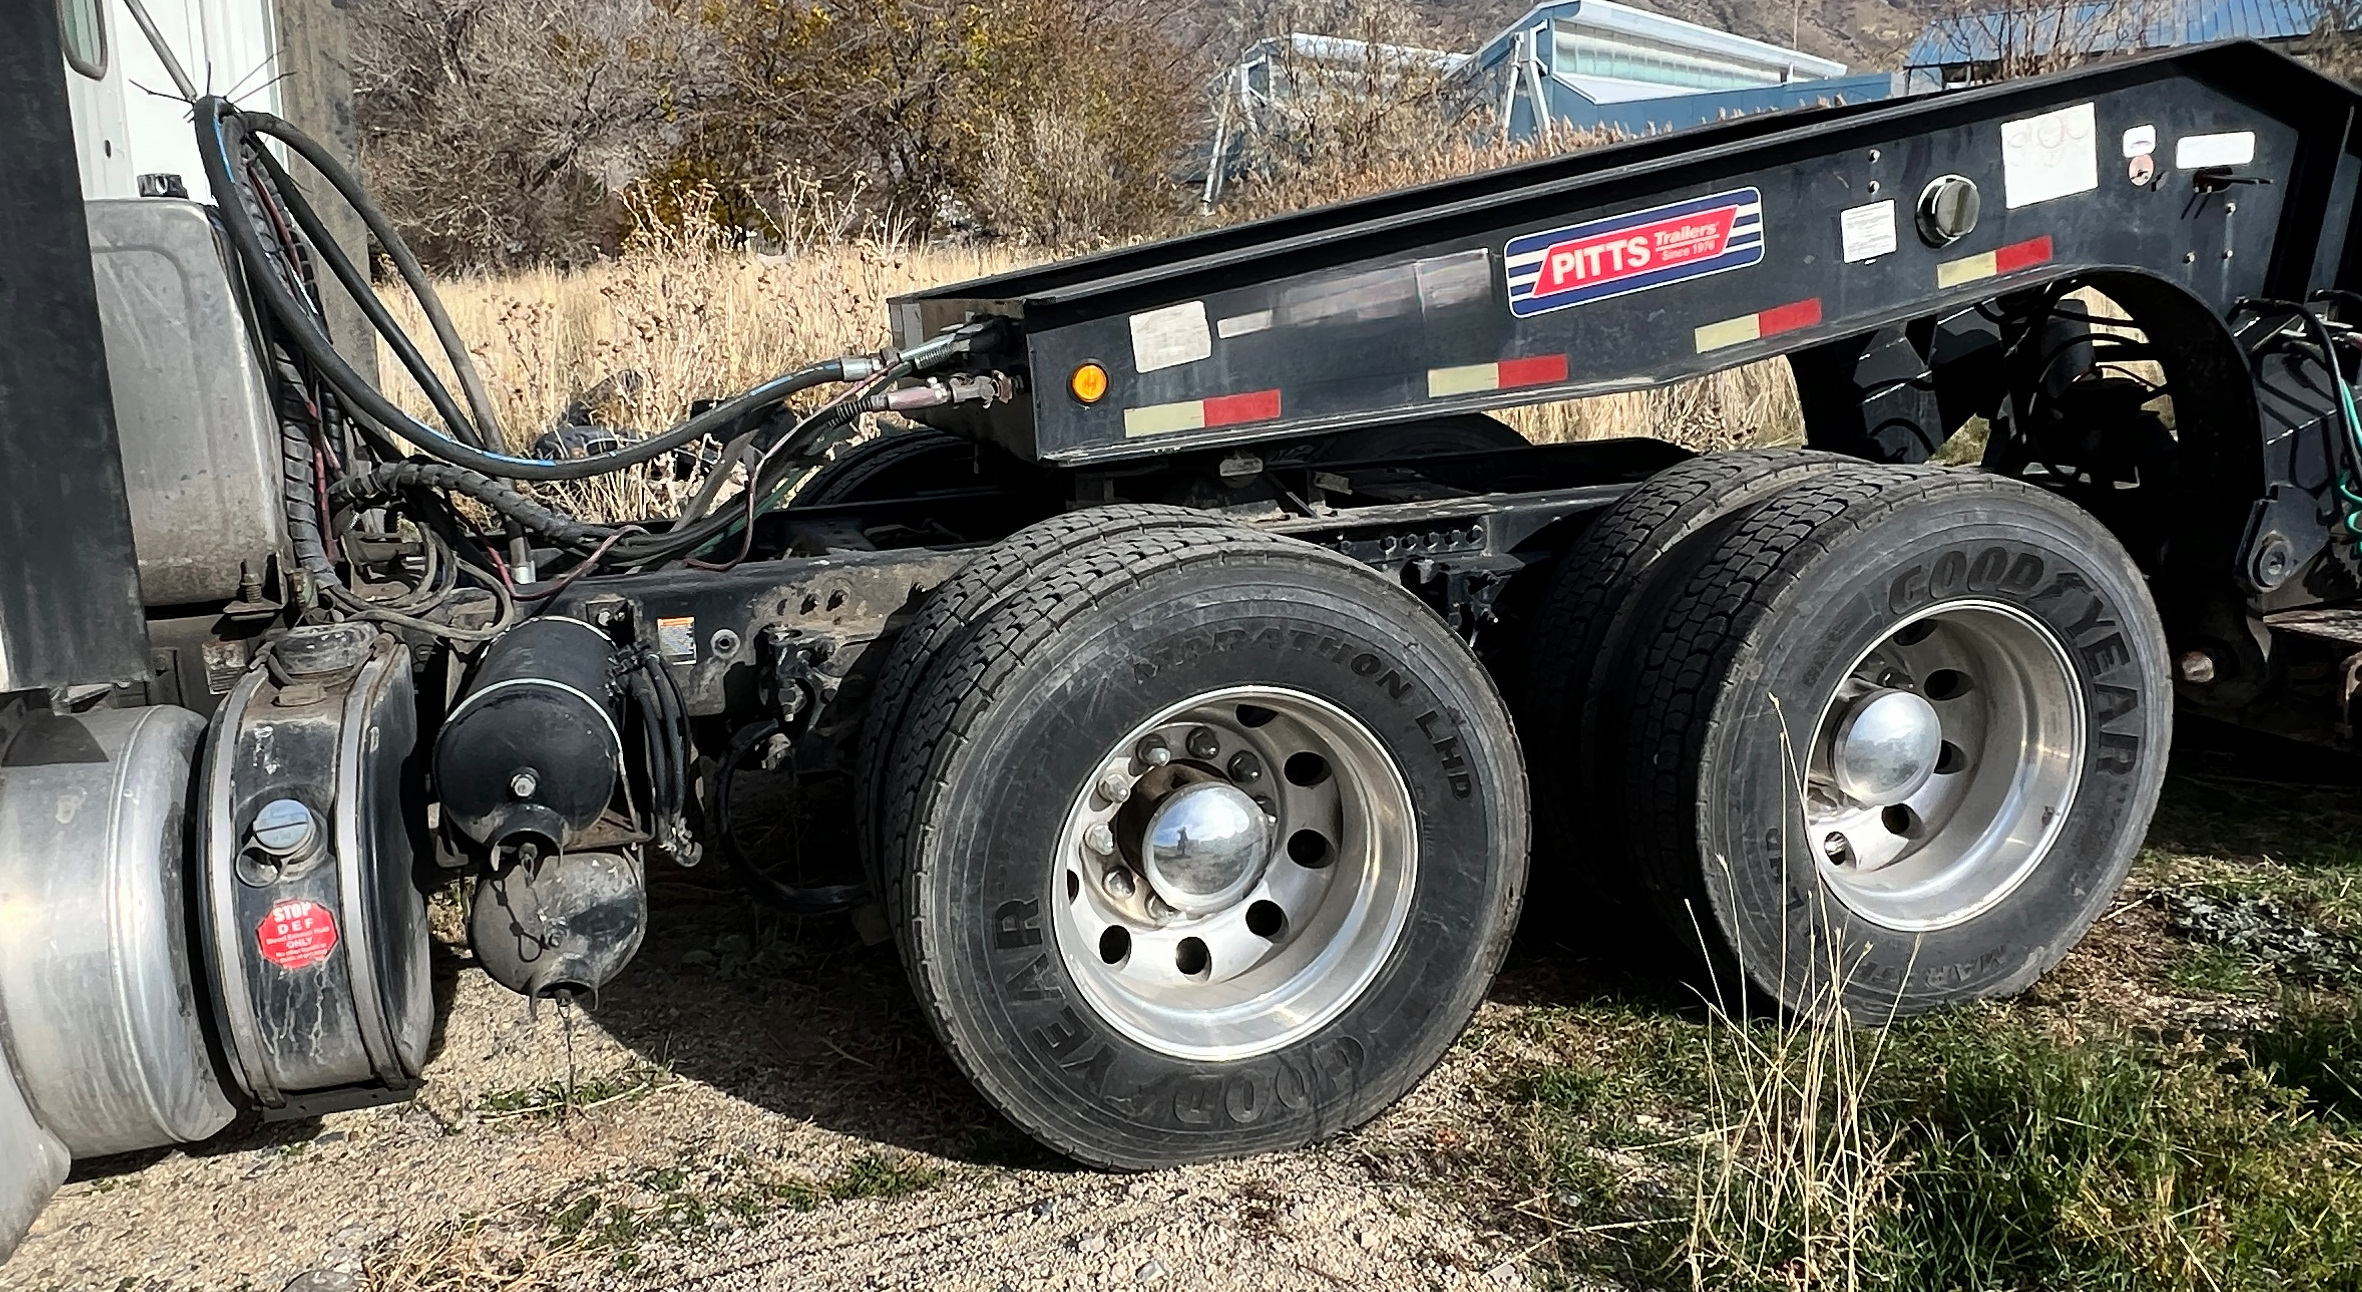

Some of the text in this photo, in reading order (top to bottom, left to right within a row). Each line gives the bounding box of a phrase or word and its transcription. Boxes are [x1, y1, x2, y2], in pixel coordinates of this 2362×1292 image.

[1654, 222, 1717, 246] Trailers
[1552, 237, 1651, 285] PITTS
[1414, 710, 1473, 800] LHD
[273, 902, 312, 922] STOP
[286, 936, 313, 949] ONLY
